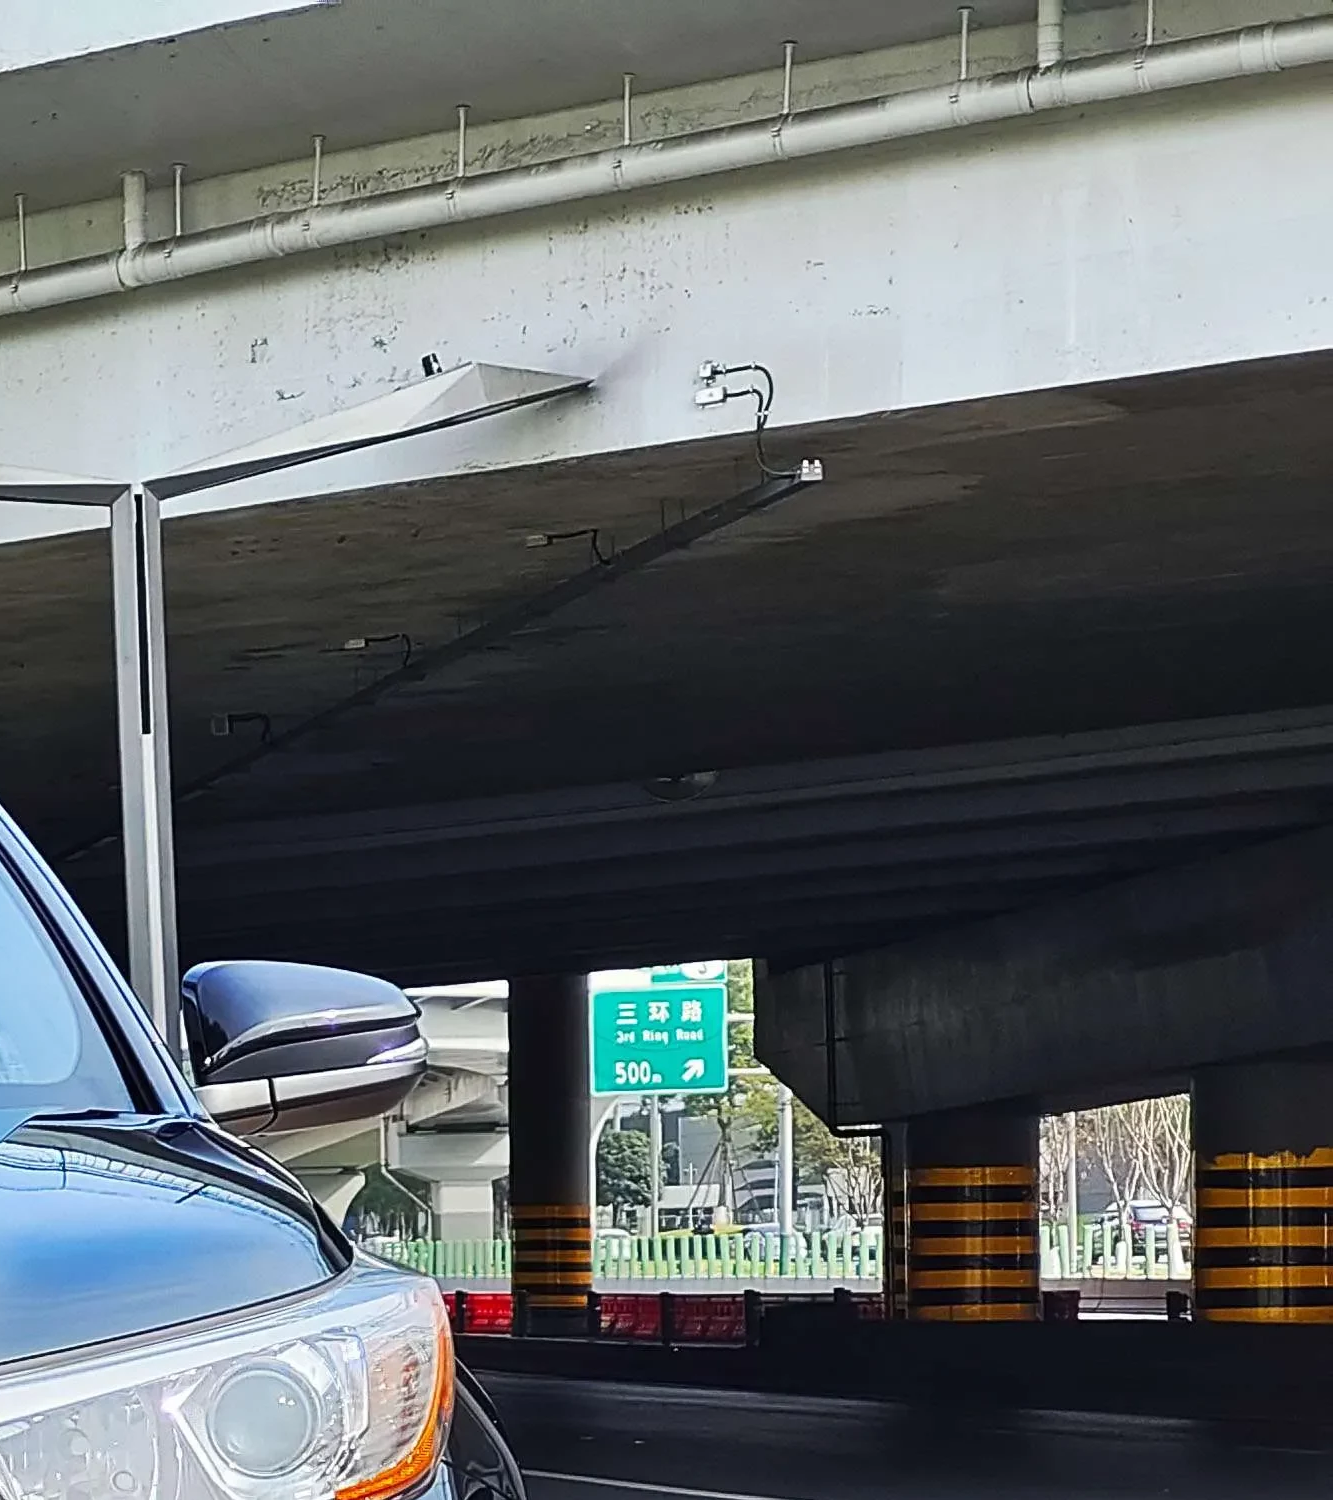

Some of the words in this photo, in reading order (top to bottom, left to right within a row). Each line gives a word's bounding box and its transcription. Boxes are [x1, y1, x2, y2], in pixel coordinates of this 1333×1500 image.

[615, 999, 703, 1025] 三环路
[616, 1030, 636, 1044] 3rd
[642, 1029, 670, 1046] Ring
[675, 1027, 704, 1041] Road
